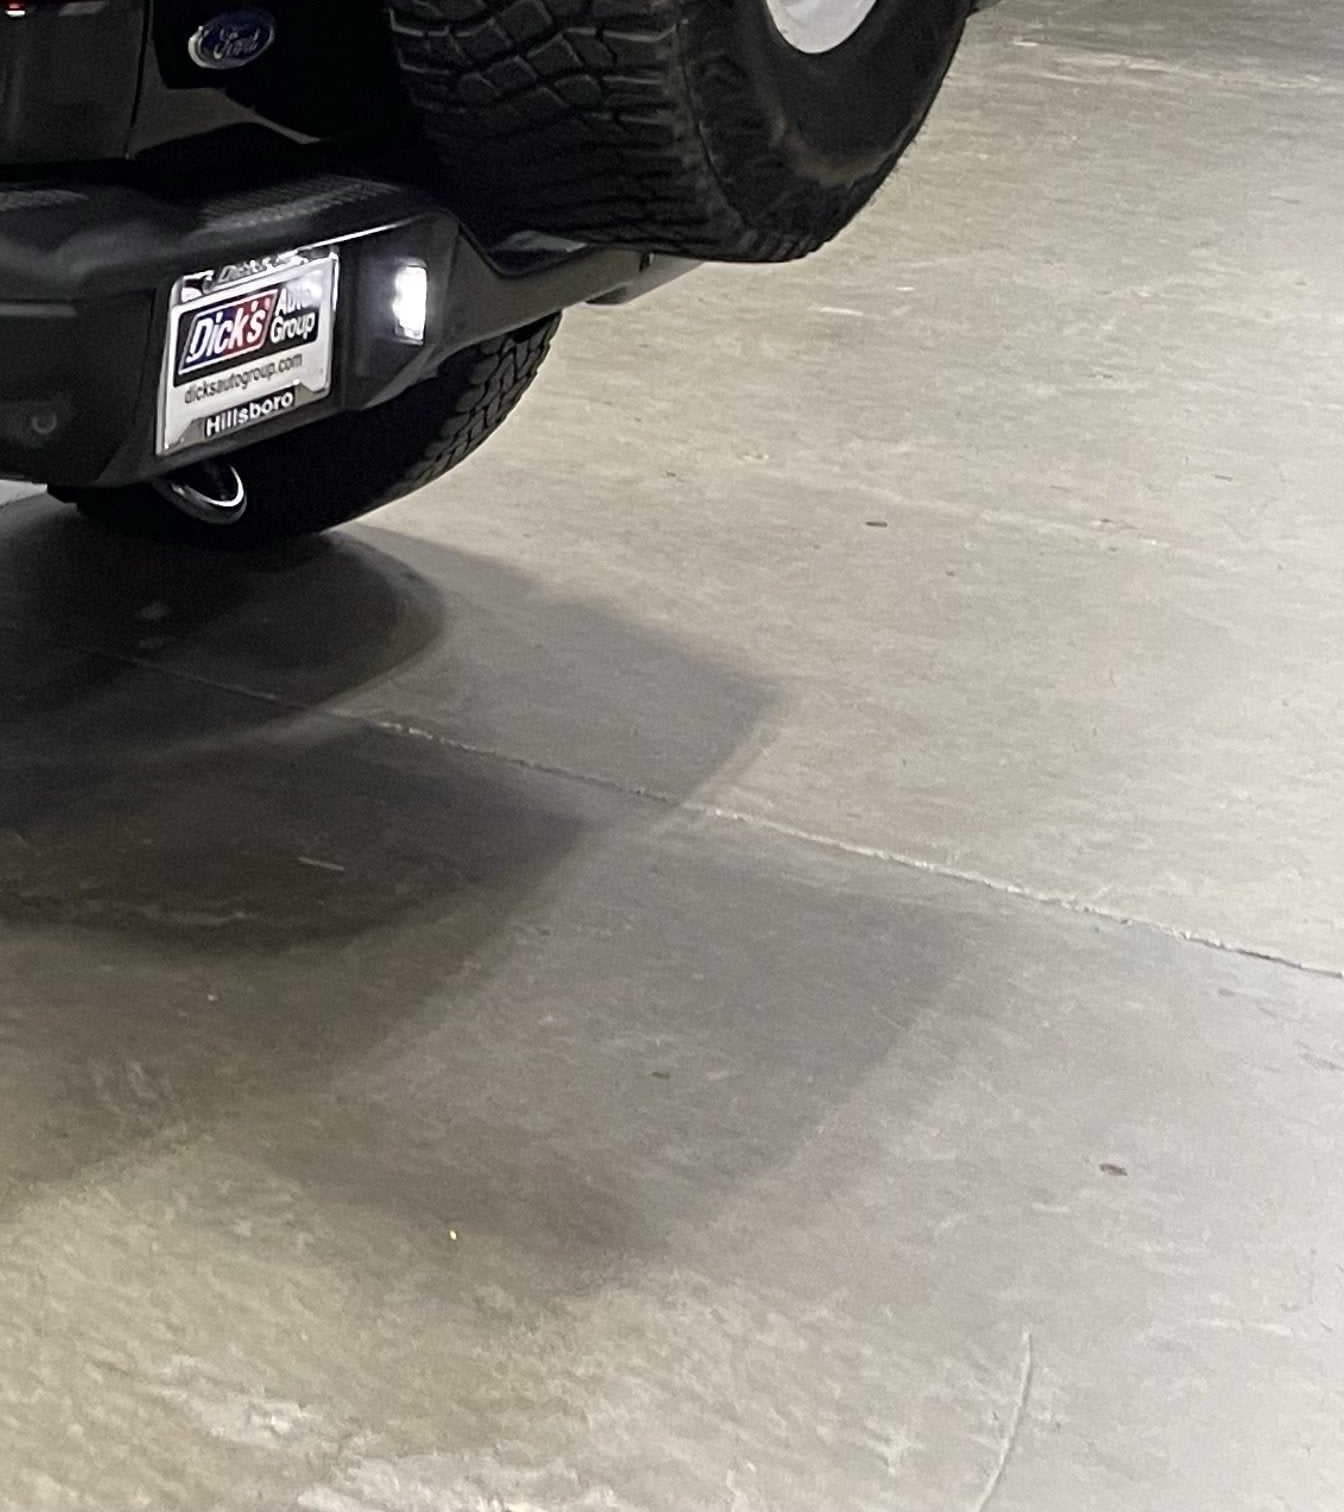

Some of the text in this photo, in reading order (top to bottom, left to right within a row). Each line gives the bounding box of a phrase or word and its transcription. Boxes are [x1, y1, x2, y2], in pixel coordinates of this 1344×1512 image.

[186, 300, 266, 364] Dick's
[271, 313, 315, 343] Group
[206, 391, 294, 437] Hillsboro
